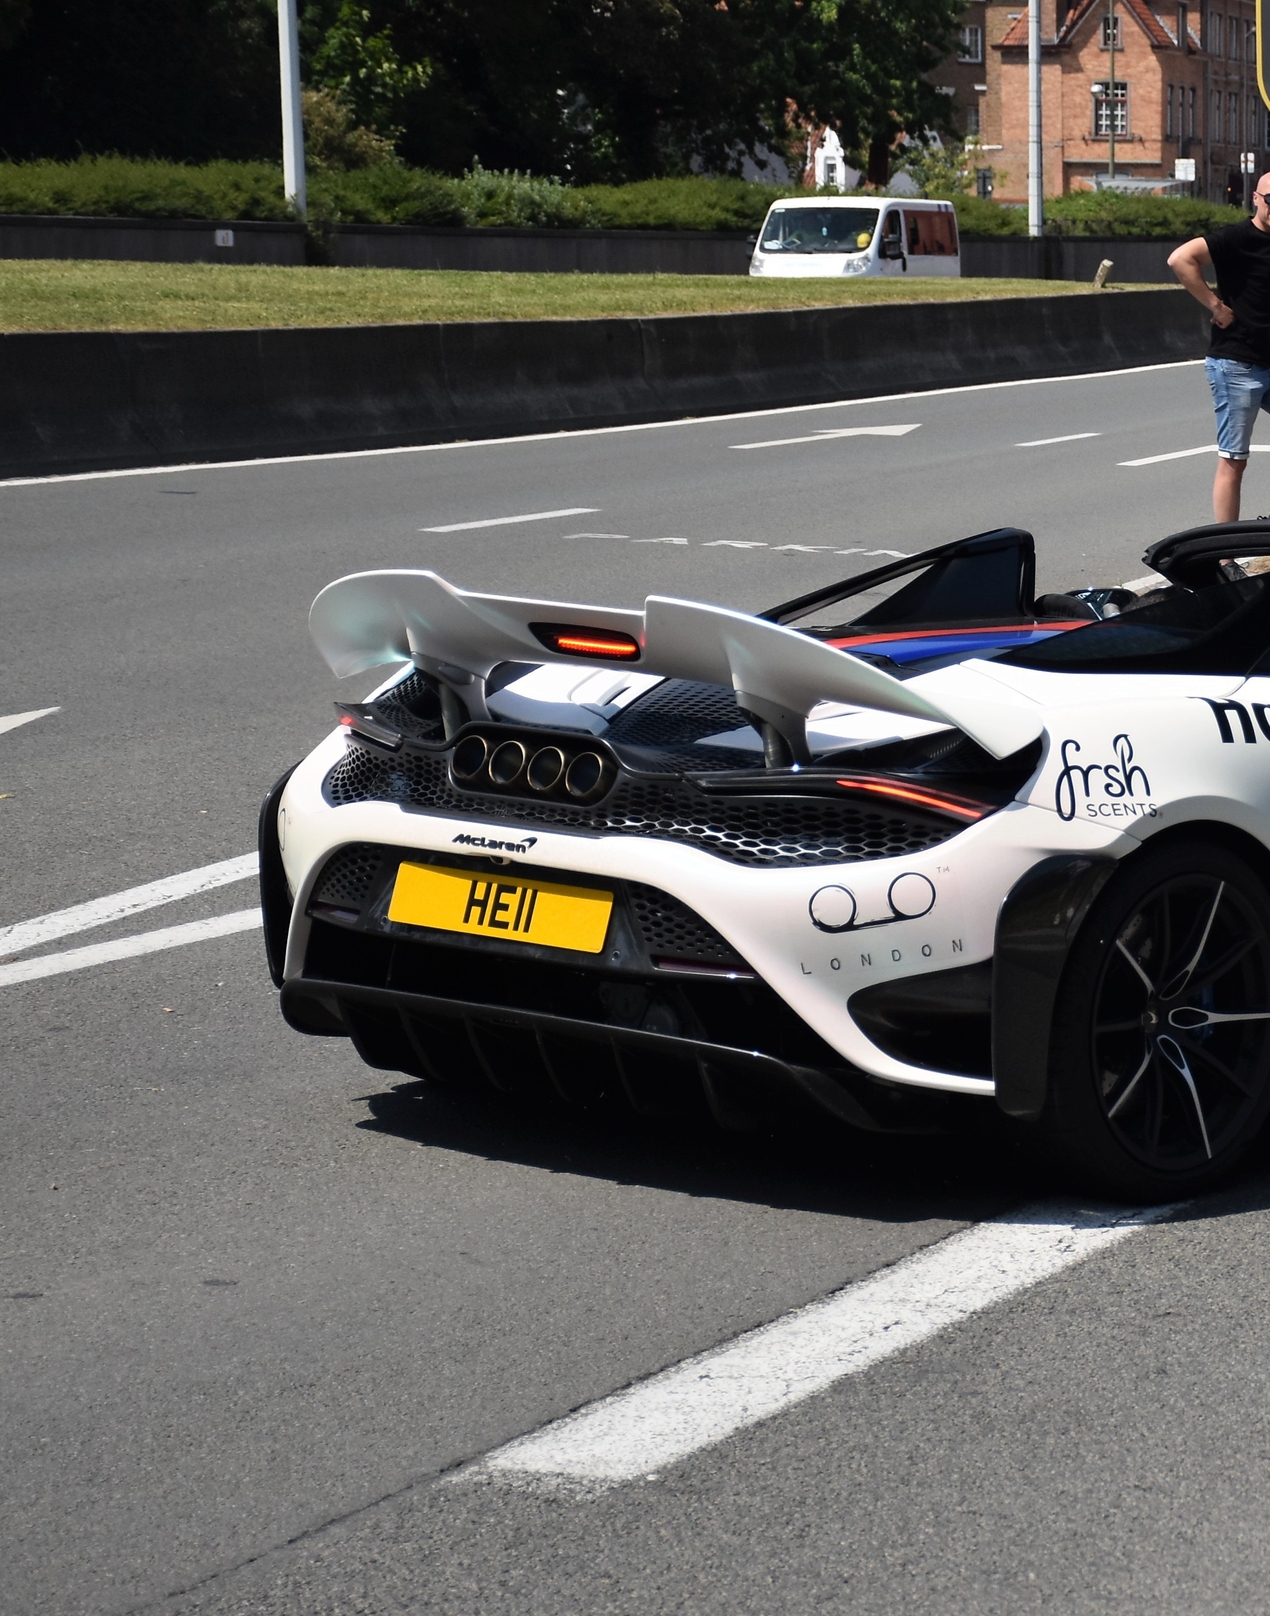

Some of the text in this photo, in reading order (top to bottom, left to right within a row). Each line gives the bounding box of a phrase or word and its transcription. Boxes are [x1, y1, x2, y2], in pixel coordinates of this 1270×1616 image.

[1055, 733, 1151, 822] frsh
[1086, 803, 1158, 817] SCENTS
[452, 833, 528, 854] McLaren
[801, 938, 963, 975] LONDON
